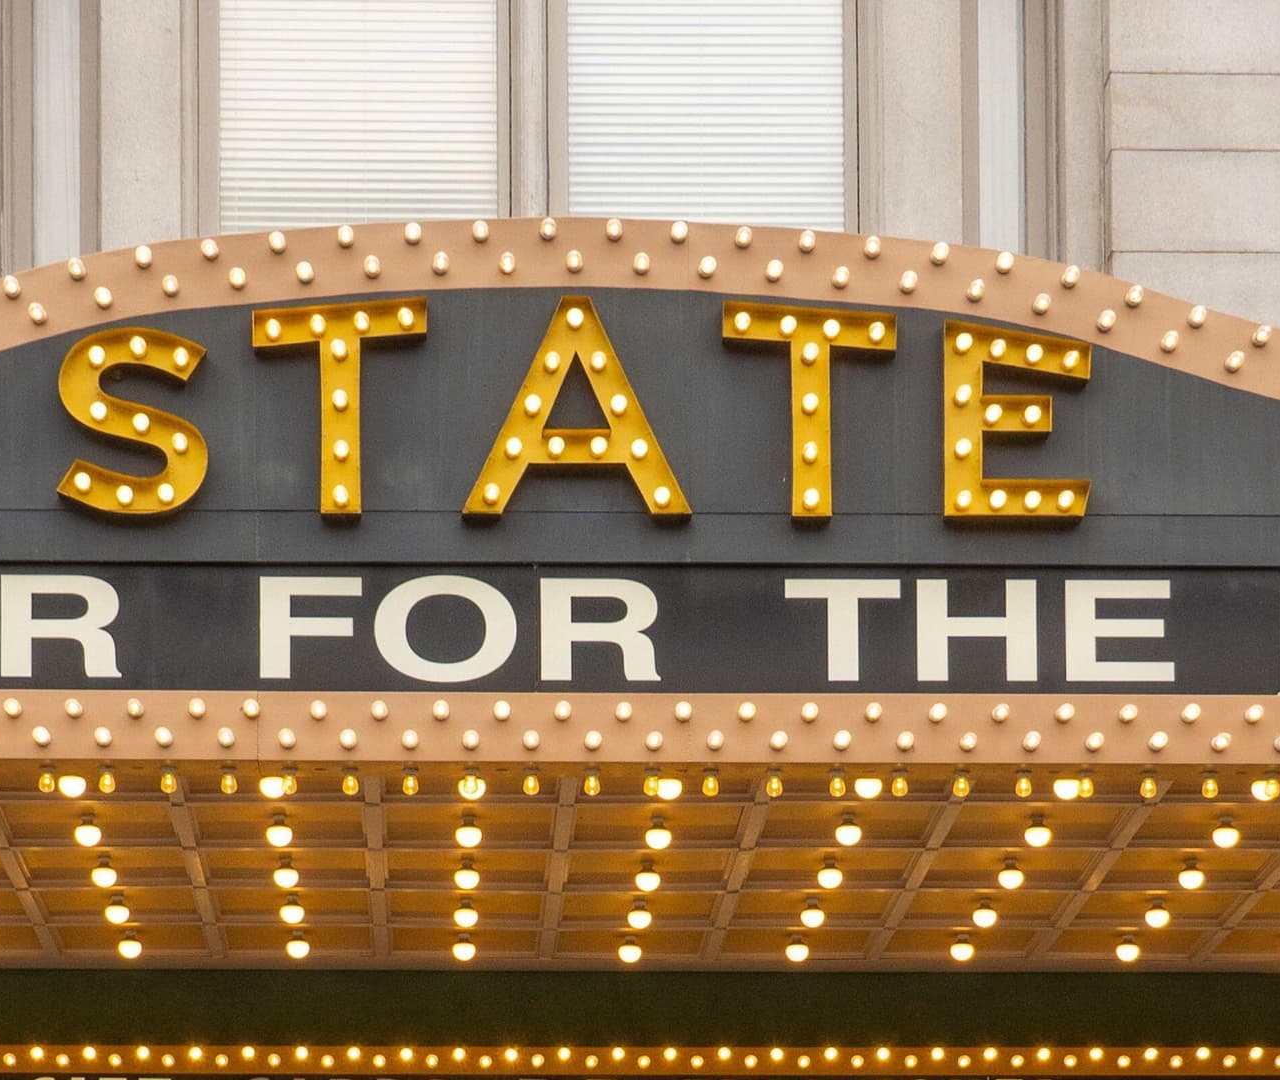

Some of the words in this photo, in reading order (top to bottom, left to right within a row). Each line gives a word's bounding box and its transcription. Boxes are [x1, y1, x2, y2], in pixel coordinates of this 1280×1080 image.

[57, 295, 1092, 525] STATE
[259, 575, 662, 683] FOR
[784, 578, 1175, 682] THE
